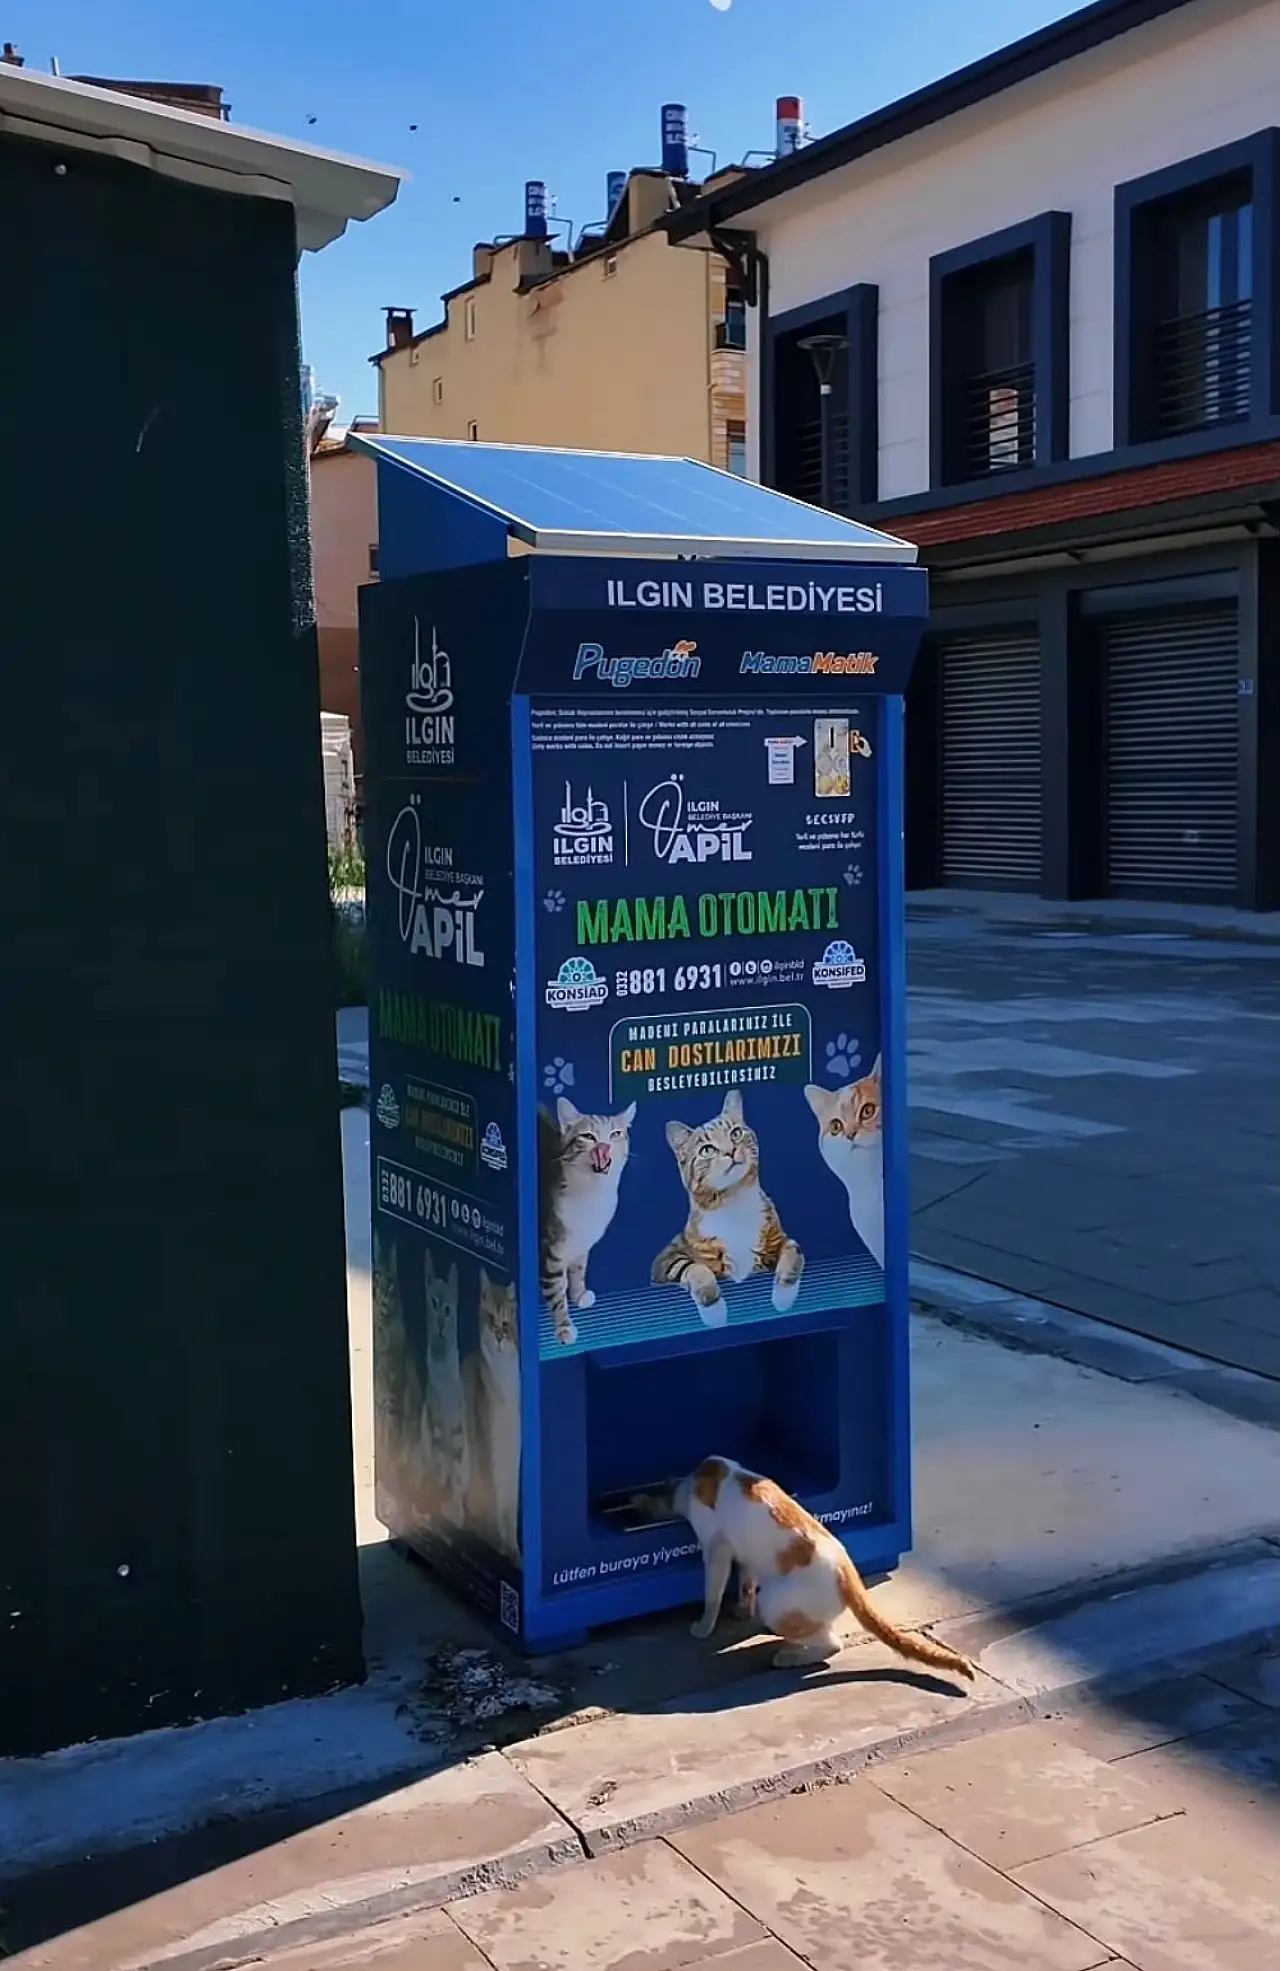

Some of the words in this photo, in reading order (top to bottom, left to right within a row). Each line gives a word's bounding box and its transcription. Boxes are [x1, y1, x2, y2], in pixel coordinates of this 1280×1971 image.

[606, 580, 693, 609] ILGIN
[704, 580, 883, 613] BELEDİYESİ
[573, 642, 701, 687] Pugedön
[739, 650, 879, 675] MamaMatik
[405, 716, 455, 745] ILGIN
[687, 801, 719, 812] ILGIN
[424, 846, 453, 867] ILGIN
[554, 836, 613, 855] ILGIN
[554, 854, 614, 866] BELEDİYESİ
[576, 895, 692, 946] MAMA
[698, 887, 840, 938] OTOMATI
[629, 967, 665, 995] 881
[674, 963, 721, 991] 6931
[620, 1048, 657, 1074] CAN
[667, 1034, 802, 1069] DOSTLARIMIZI
[389, 1173, 413, 1214] 881
[415, 1183, 448, 1229] 6931
[553, 1563, 597, 1585] Lütfen
[599, 1552, 650, 1575] buraya
